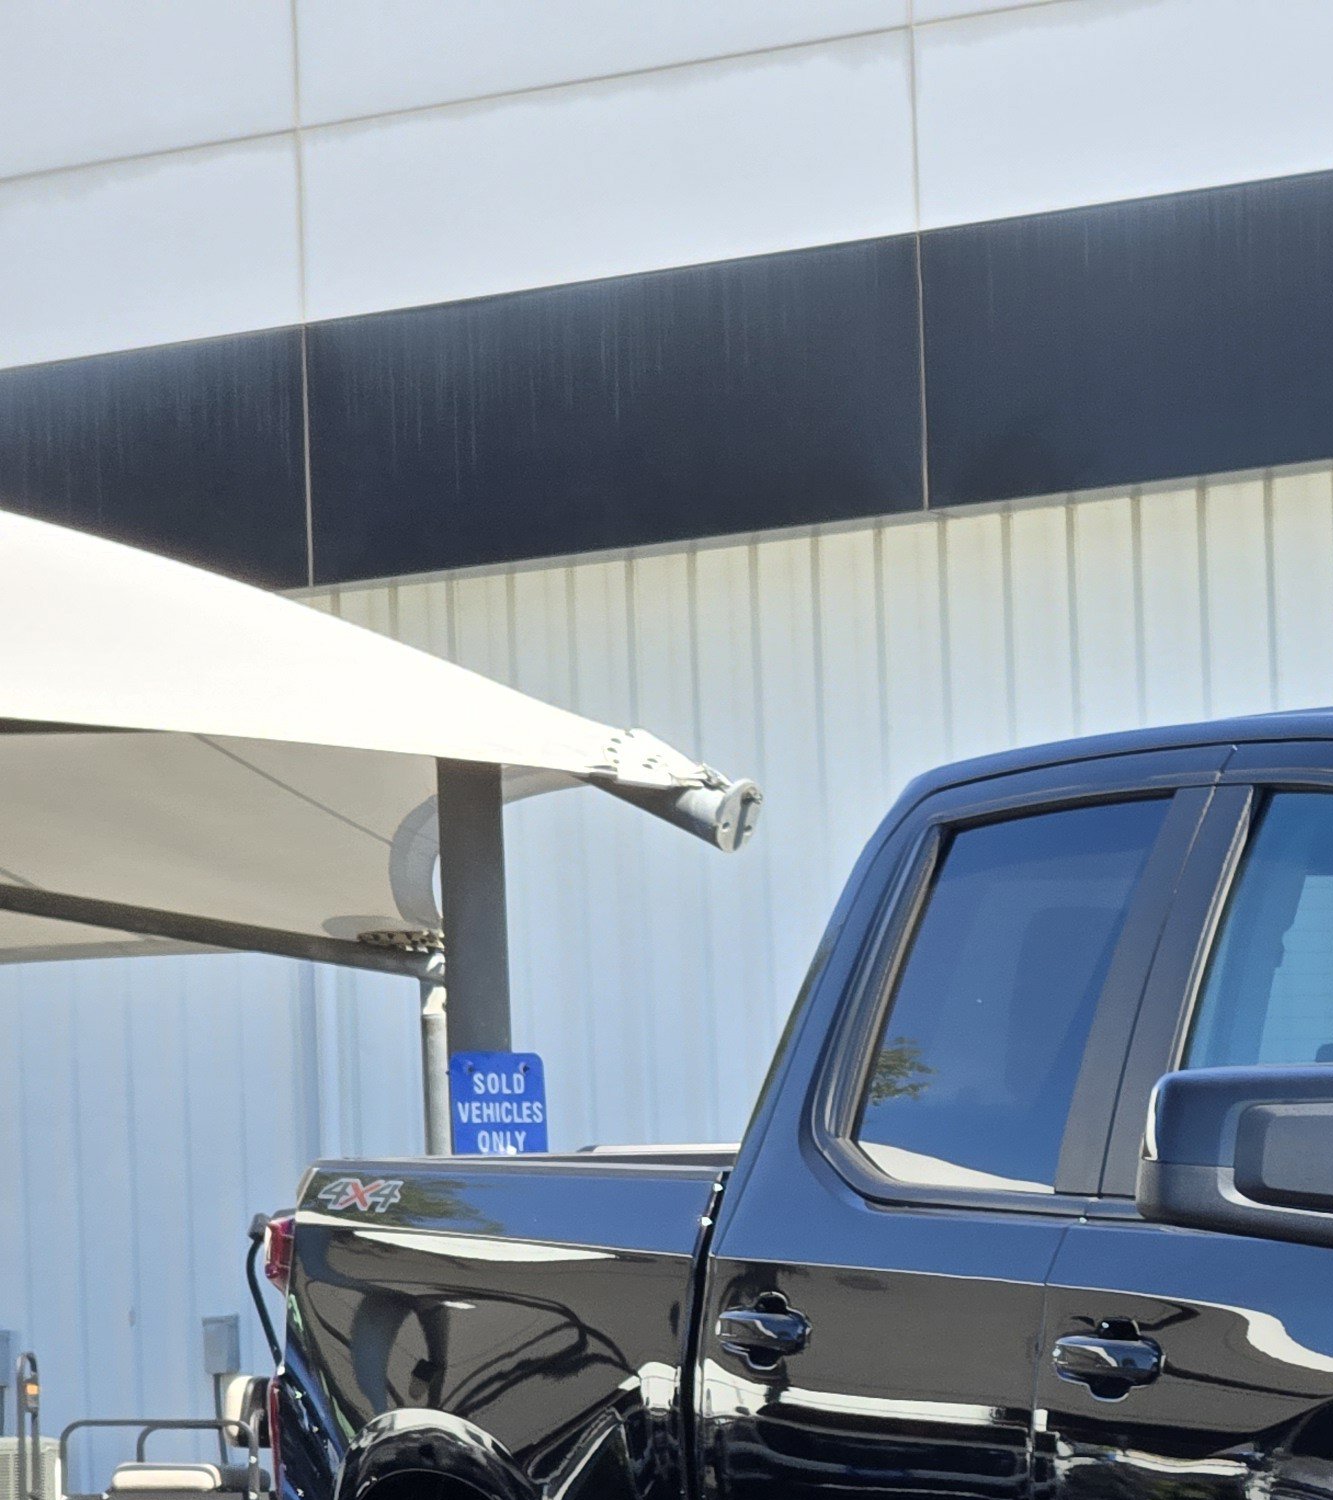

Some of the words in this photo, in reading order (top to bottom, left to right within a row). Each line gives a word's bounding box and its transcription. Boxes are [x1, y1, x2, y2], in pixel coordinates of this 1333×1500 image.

[473, 1072, 525, 1094] SOLD
[457, 1101, 544, 1124] VEHICLES
[477, 1130, 527, 1154] ONLY
